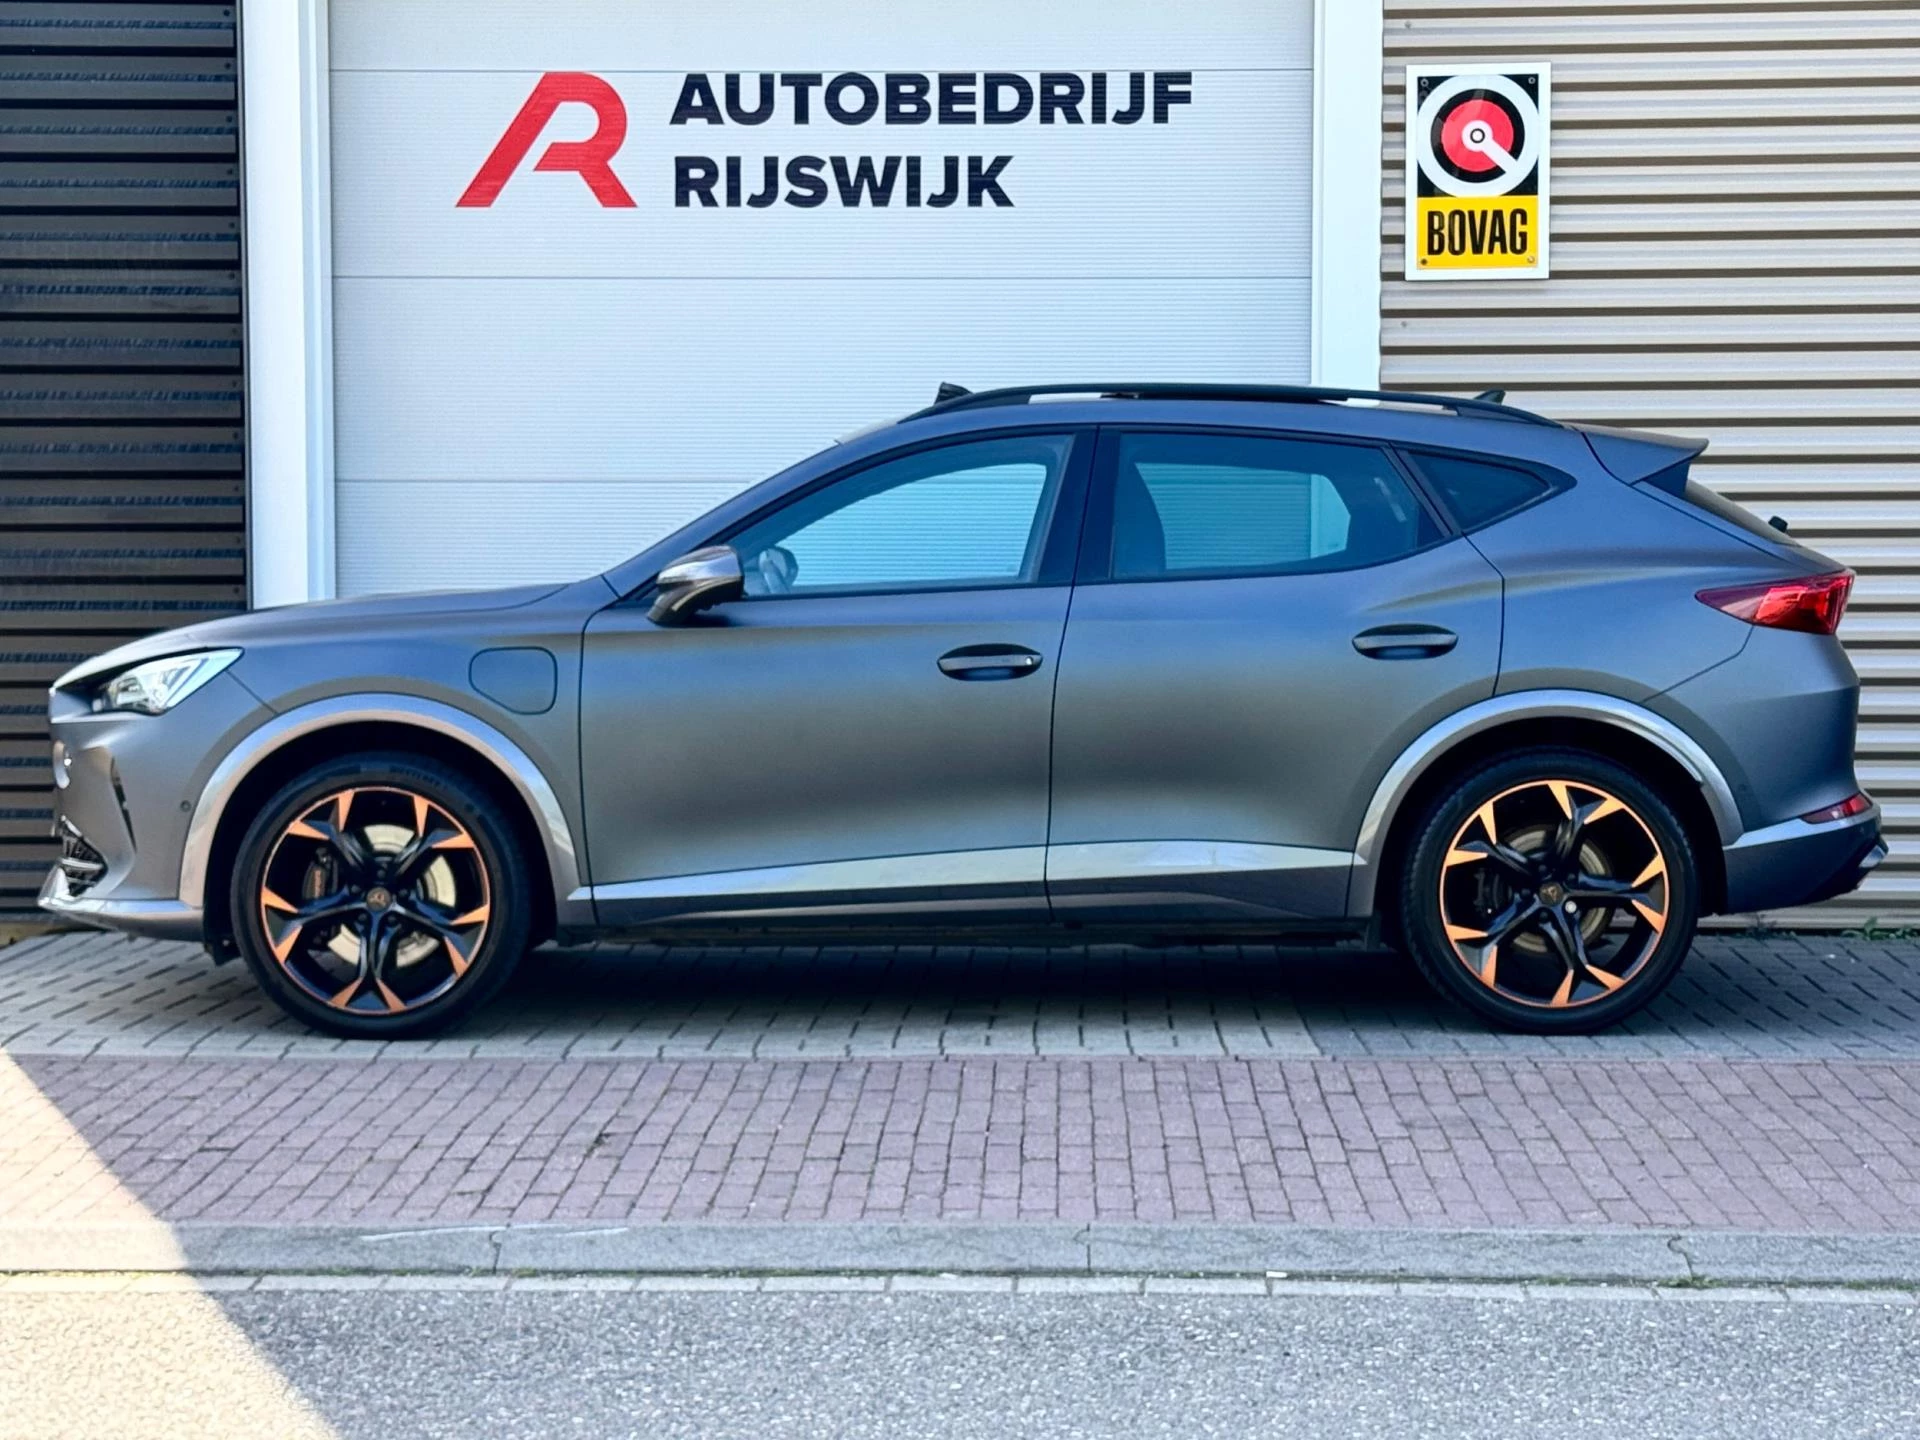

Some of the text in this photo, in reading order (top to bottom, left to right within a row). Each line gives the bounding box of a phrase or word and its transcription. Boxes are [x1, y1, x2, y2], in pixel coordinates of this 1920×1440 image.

[669, 71, 1193, 126] AUTOBEDRIJF
[674, 155, 1016, 208] RIJSWIJK
[1427, 208, 1528, 256] BOVAG
